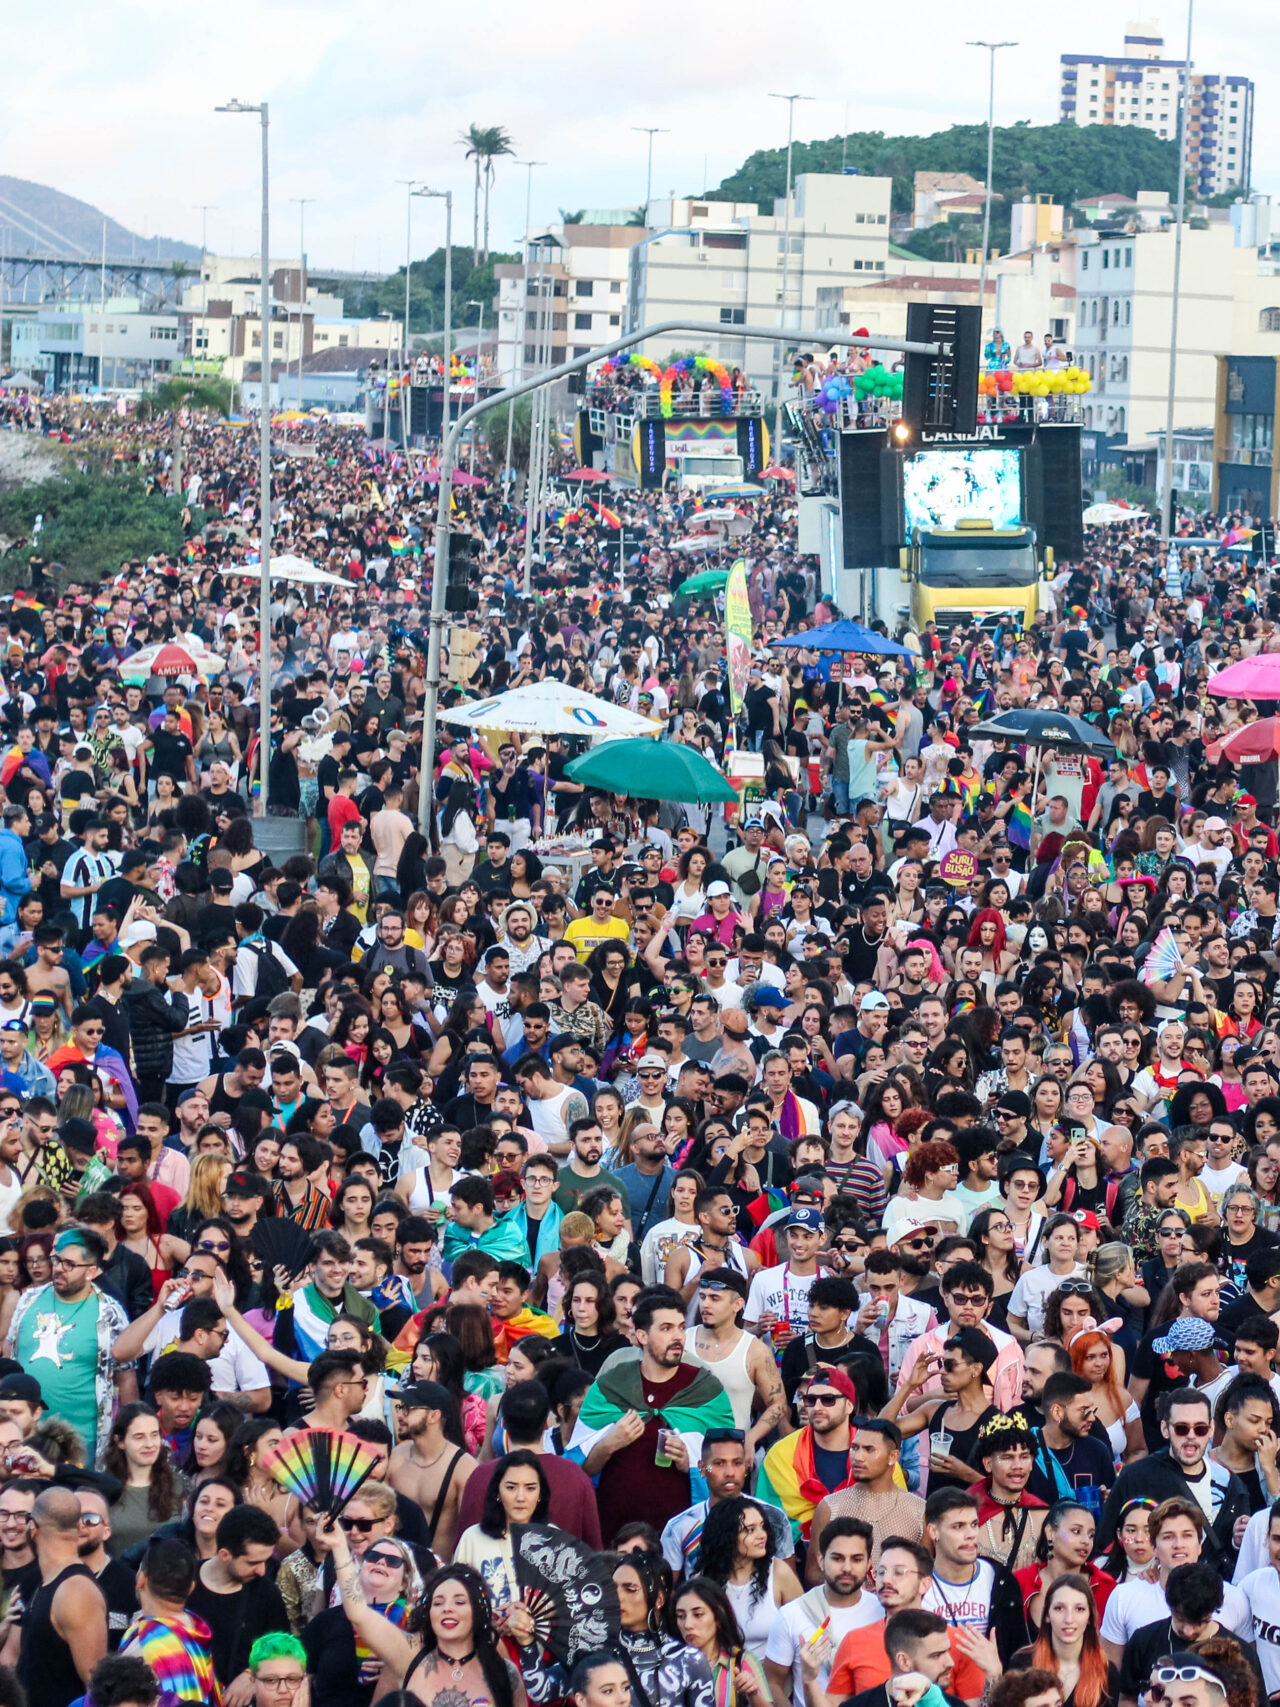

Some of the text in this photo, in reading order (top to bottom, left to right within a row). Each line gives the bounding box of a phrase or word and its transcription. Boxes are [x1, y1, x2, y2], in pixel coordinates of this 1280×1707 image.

[157, 664, 191, 677] AMSTEL
[1239, 755, 1261, 763] BRAHMA
[950, 853, 974, 867] SURU
[945, 863, 974, 877] BUSÃO
[766, 1288, 796, 1307] WET
[931, 1601, 987, 1620] WONDER
